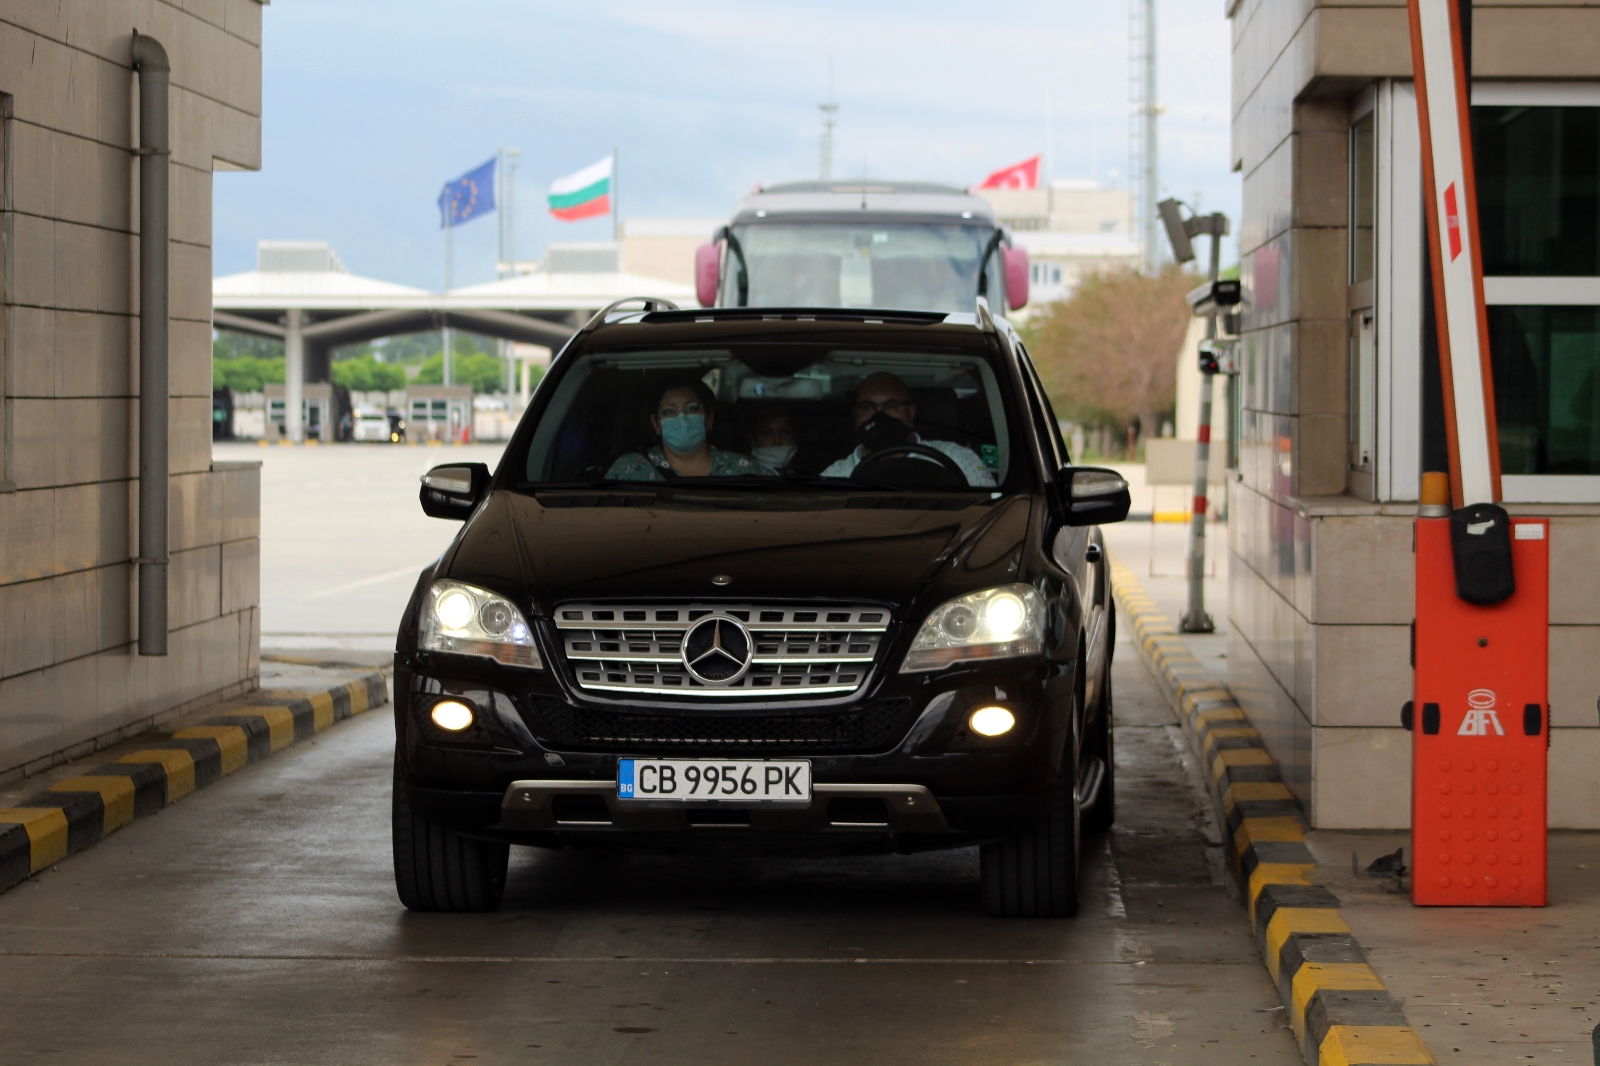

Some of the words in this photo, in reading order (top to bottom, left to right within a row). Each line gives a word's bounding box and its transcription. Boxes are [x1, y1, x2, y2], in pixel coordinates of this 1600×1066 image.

[1456, 709, 1504, 736] BFT
[620, 783, 633, 793] BG
[639, 765, 677, 794] CB
[684, 765, 757, 795] 9956
[764, 766, 802, 795] PK
